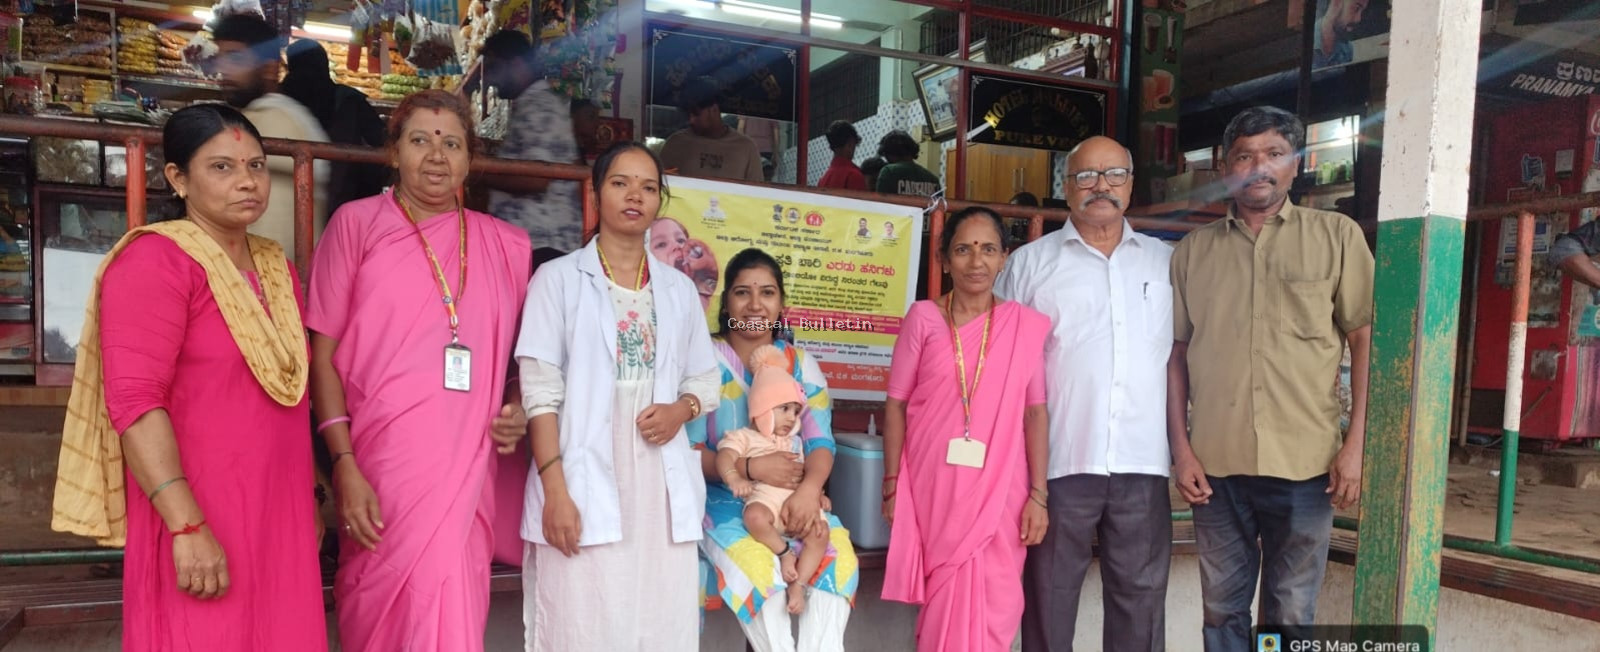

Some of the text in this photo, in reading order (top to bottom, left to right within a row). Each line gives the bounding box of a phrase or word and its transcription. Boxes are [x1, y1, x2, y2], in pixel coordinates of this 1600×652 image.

[995, 130, 1044, 145] PURE
[799, 258, 821, 268] ಬಾರಿ
[826, 260, 855, 272] ಎರಡು
[860, 262, 895, 276] ಹನಿಗಳು
